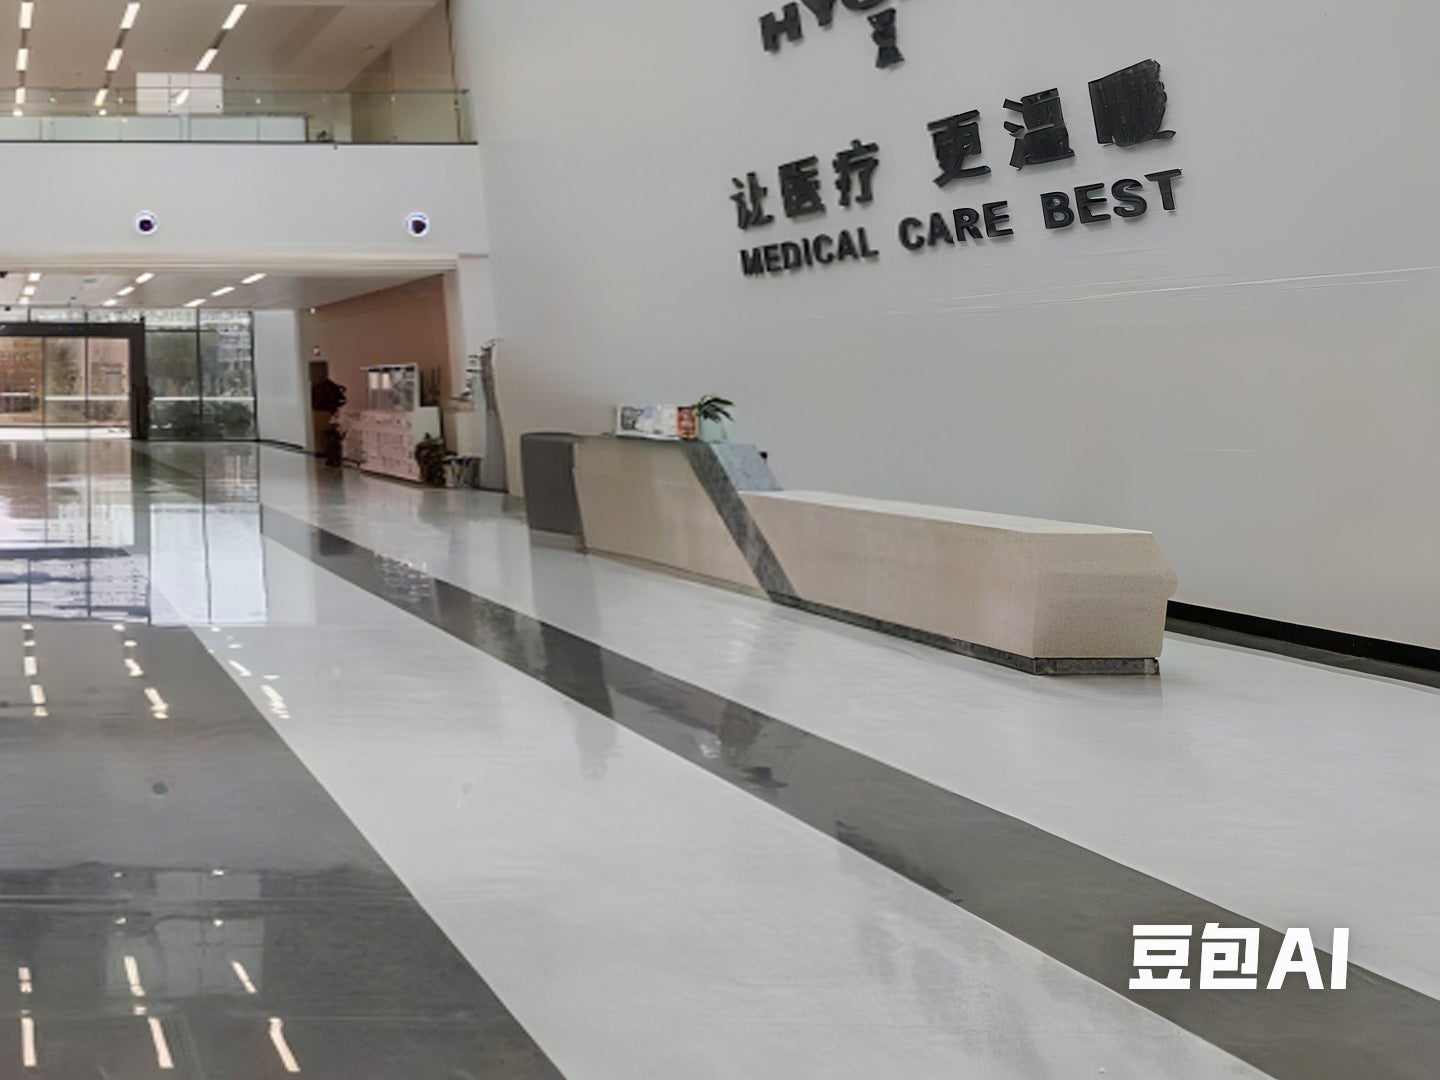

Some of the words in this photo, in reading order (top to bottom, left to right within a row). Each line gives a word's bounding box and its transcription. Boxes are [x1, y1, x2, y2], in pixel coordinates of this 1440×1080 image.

[730, 139, 880, 230] 让医疗
[740, 226, 880, 277] MEDICAL
[898, 200, 1015, 252] CARE
[1040, 168, 1183, 230] BEST
